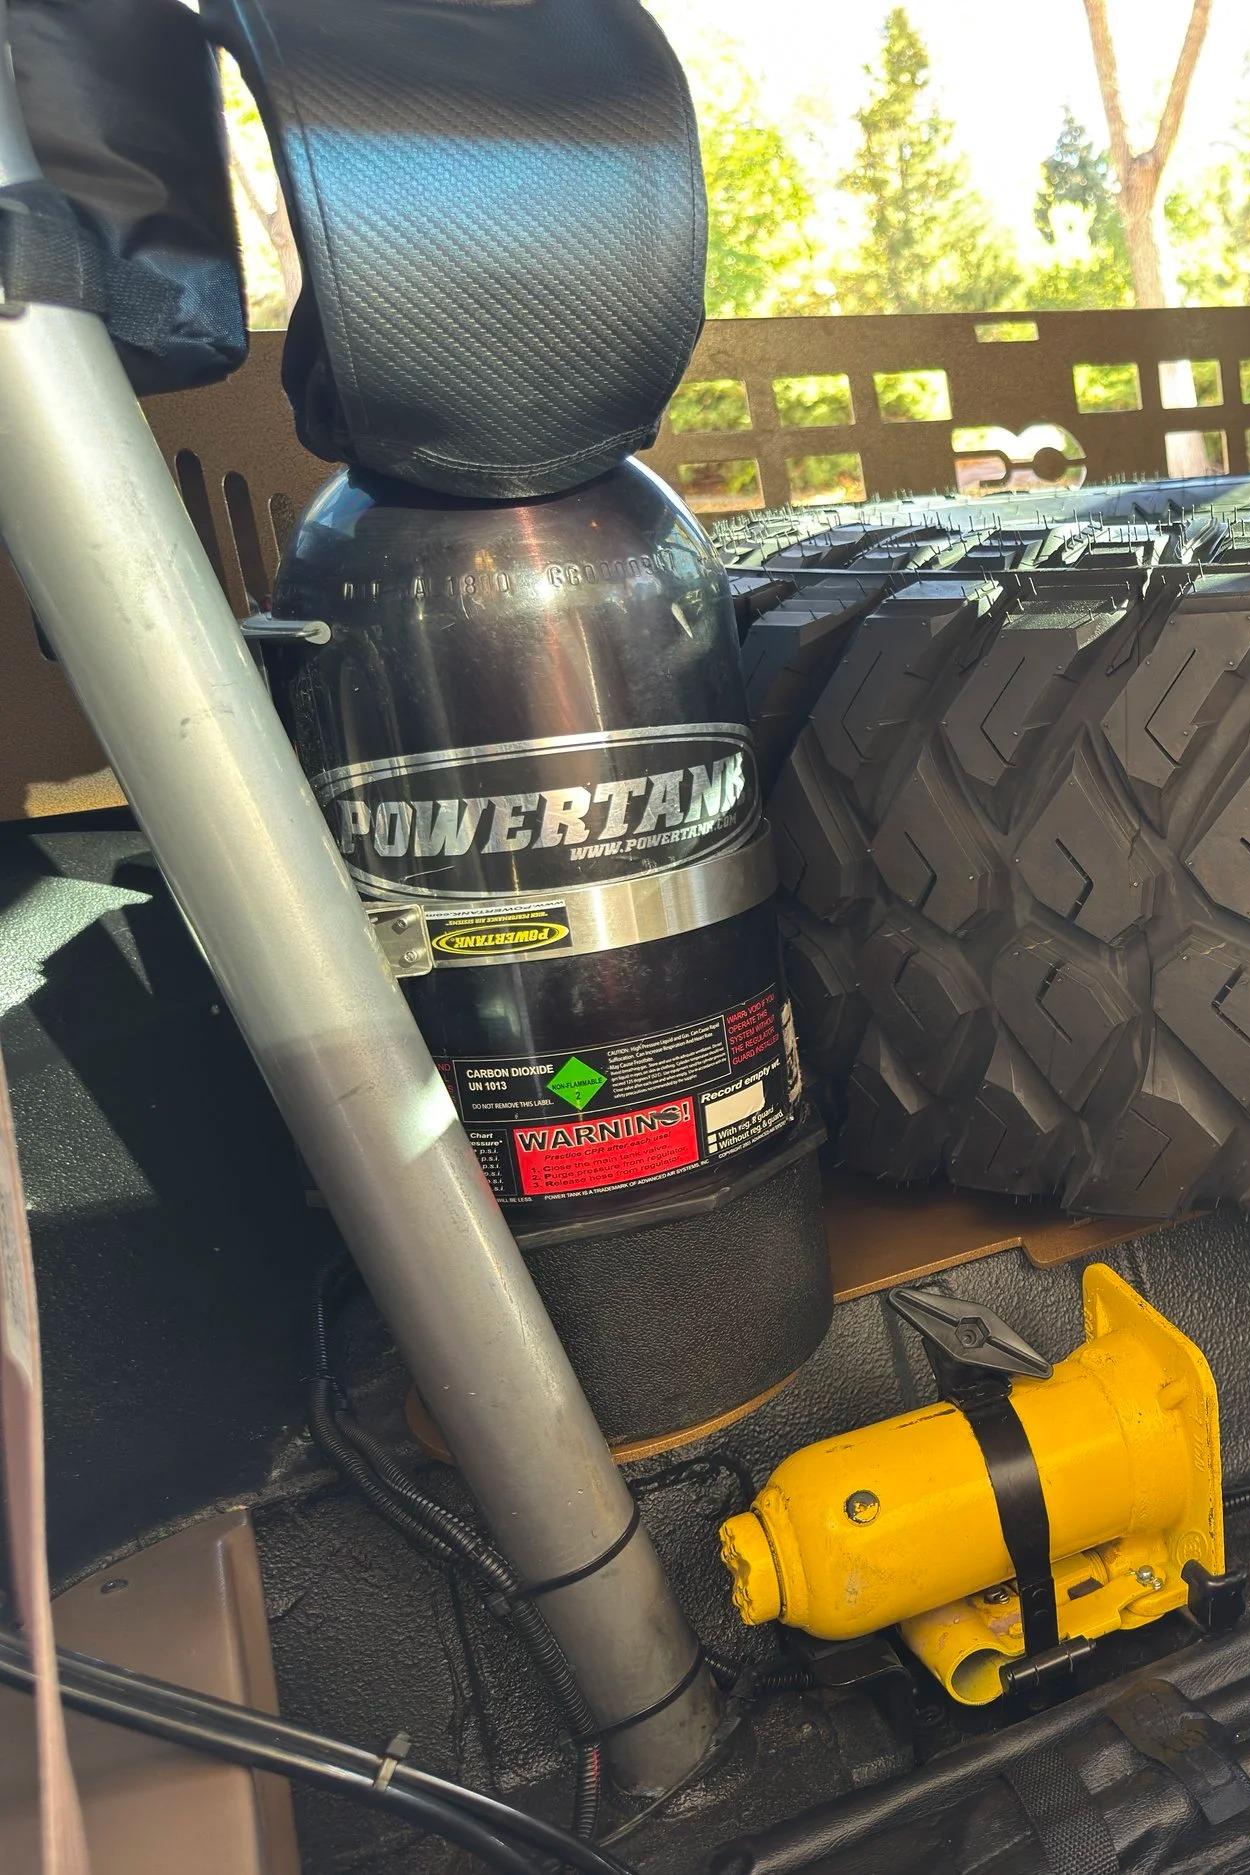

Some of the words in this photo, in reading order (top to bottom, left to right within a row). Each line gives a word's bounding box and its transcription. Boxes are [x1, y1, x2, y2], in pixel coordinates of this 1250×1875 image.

[337, 751, 746, 858] POWERTANK
[570, 812, 738, 861] WWW.POWERTANK.COM
[728, 1016, 756, 1034] OPERATE
[757, 1009, 768, 1020] THIS
[729, 1027, 755, 1044] SYSTEM
[755, 1014, 775, 1032] WITHOUT
[731, 1043, 745, 1054] THE
[745, 1026, 775, 1048] REGULATOR
[732, 1049, 756, 1065] GUARD
[466, 1068, 510, 1079] CARBON
[511, 1064, 555, 1077] DIOXIDE
[468, 1082, 483, 1091] UN
[485, 1081, 508, 1091] 1013
[551, 1077, 603, 1091] NON-FLAMMABLE
[575, 1091, 581, 1100] 2
[701, 1080, 743, 1103] Record
[744, 1067, 771, 1085] empty
[494, 1101, 520, 1109] REMOVE
[520, 1100, 534, 1108] THIS
[533, 1099, 555, 1107] LABEL.
[518, 1101, 691, 1153] WARNING!
[718, 1125, 737, 1140] With
[757, 1104, 774, 1122] guard
[719, 1130, 750, 1149] Without
[762, 1119, 768, 1128] &
[767, 1109, 784, 1127] guard
[544, 1152, 582, 1161] Practice
[584, 1147, 605, 1156] CPR
[606, 1143, 628, 1152] after
[630, 1137, 651, 1147] each
[543, 1164, 571, 1172] Close
[592, 1155, 617, 1166] main
[620, 1151, 641, 1160] tank
[544, 1172, 574, 1180] Purge
[576, 1164, 621, 1176] pressure
[623, 1158, 645, 1167] from
[544, 1193, 566, 1201] POWER
[594, 1183, 629, 1194] TRADEMARK
[637, 1173, 667, 1185] ADVANCED
[545, 1177, 587, 1187] Release
[589, 1173, 614, 1181] hose
[616, 1167, 638, 1176] from
